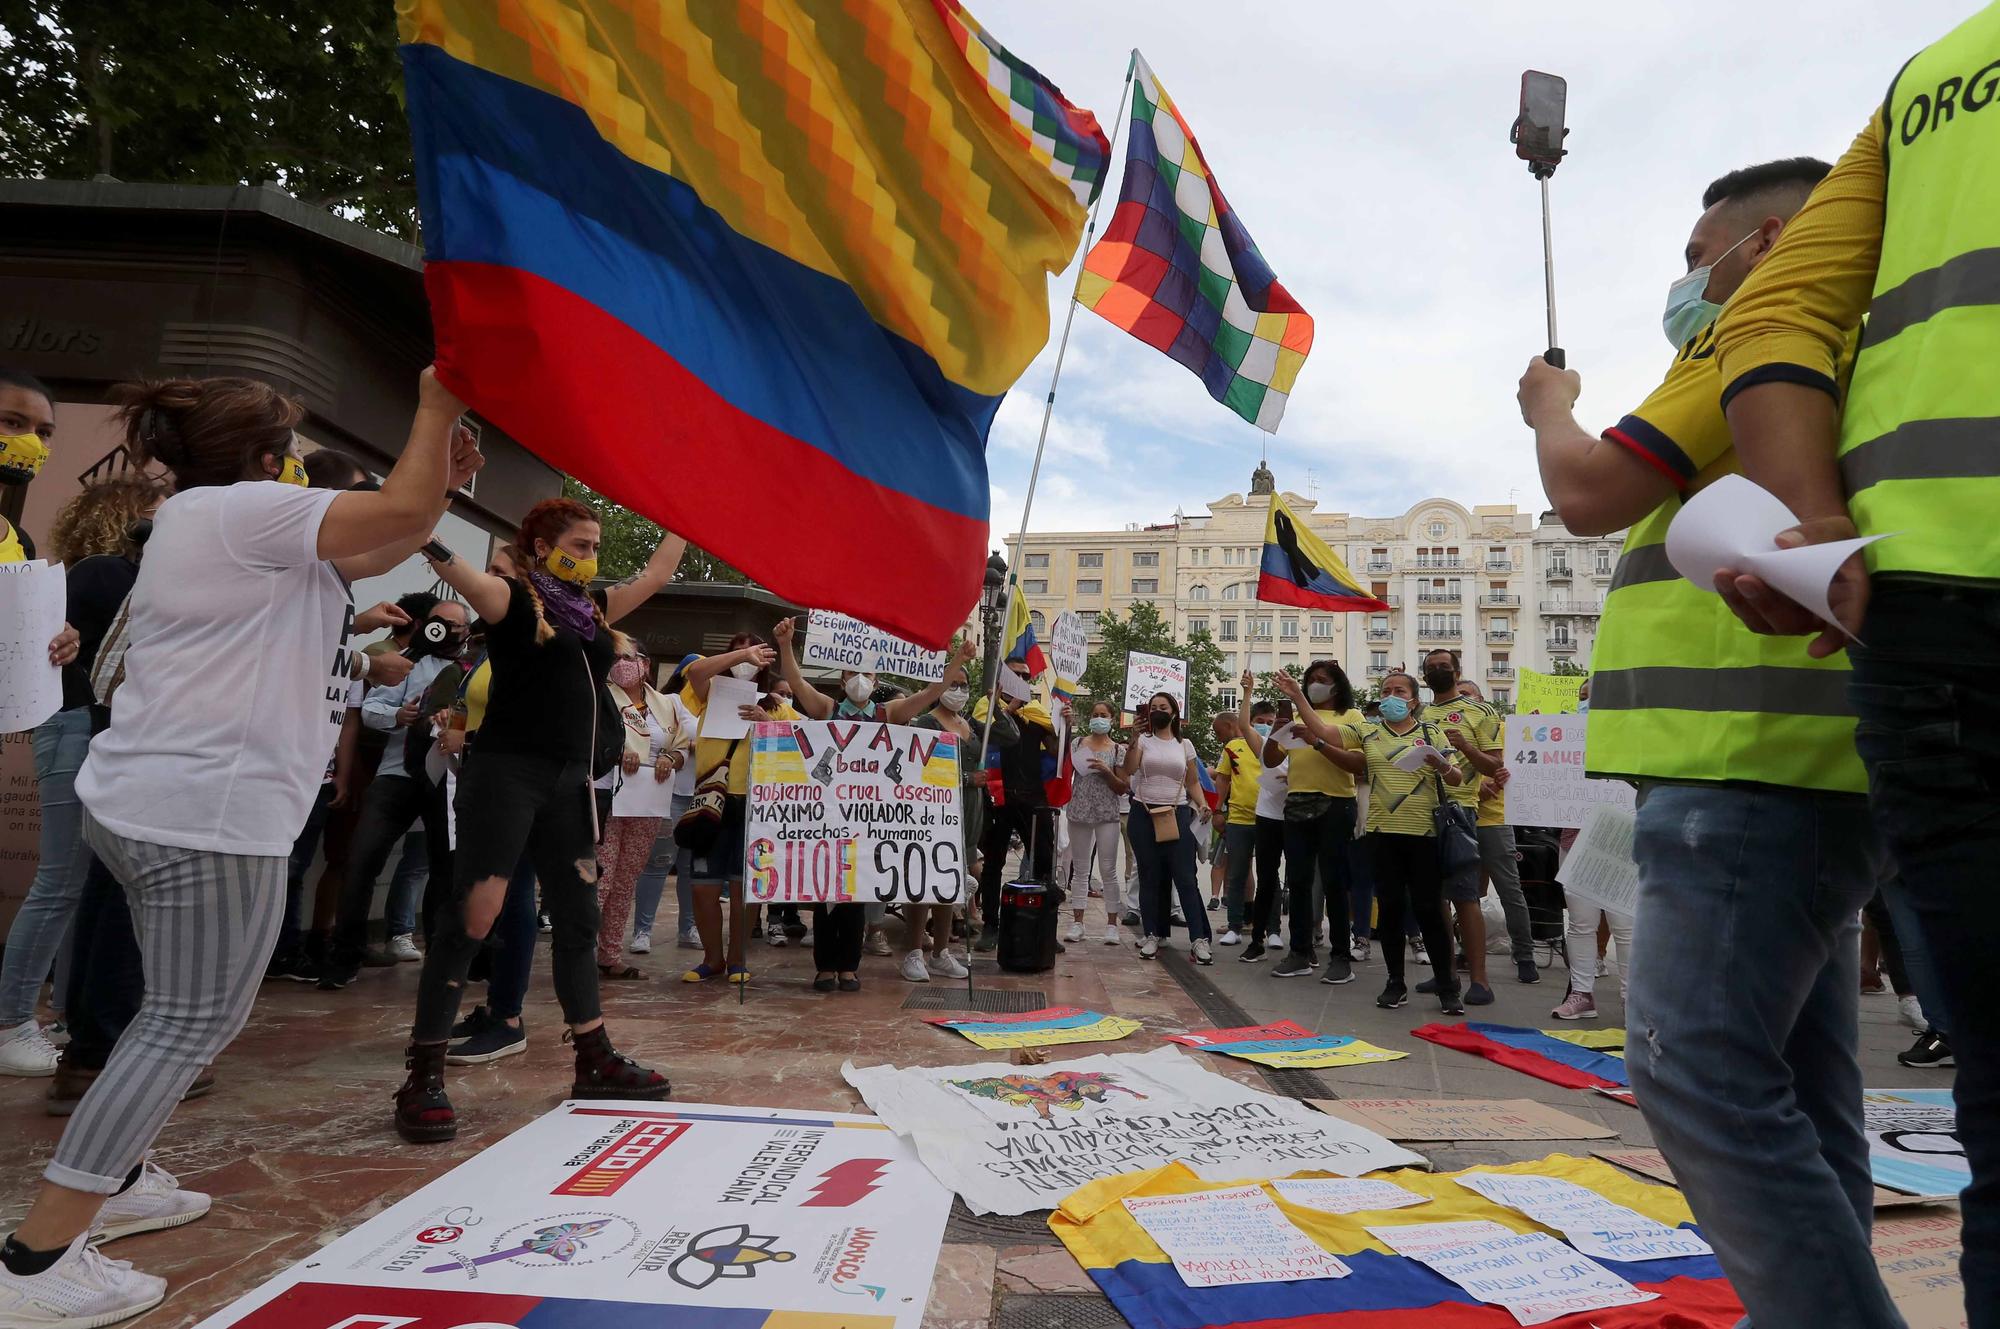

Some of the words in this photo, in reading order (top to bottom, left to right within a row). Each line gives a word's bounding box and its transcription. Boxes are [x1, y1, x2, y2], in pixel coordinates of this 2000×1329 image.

[1901, 59, 2000, 147] ORG
[8, 318, 100, 354] flors
[809, 645, 862, 666] CHALECO
[1137, 665, 1185, 682] IMPUNIDAD
[1170, 663, 1182, 672] de
[326, 687, 340, 702] LA
[1556, 687, 1579, 698] INDIFE
[330, 711, 344, 726] NU
[1522, 725, 1563, 742] 168
[1515, 750, 1538, 764] 42
[10, 776, 28, 787] Mil
[753, 783, 822, 803] gobierno
[894, 783, 953, 804] asesino
[839, 803, 917, 825] VIOLADOR
[920, 806, 936, 825] de
[941, 805, 960, 826] los
[9, 822, 24, 831] on
[777, 823, 850, 840] derechos
[867, 822, 933, 842] humanos
[874, 841, 961, 904] SOS
[595, 1124, 680, 1169] CCOO
[984, 1133, 1054, 1158] UNA
[717, 1140, 791, 1203] VALENCIANA
[751, 1130, 827, 1206] INTERSINDICAL
[381, 1244, 436, 1273] AESCO
[639, 1231, 691, 1272] REVIVIR
[1278, 1254, 1330, 1267] VIOLA
[1179, 1258, 1256, 1273] TORTURA
[1257, 1258, 1273, 1269] Y
[1320, 1262, 1344, 1276] LA
[1543, 1260, 1595, 1282] NOS
[1468, 1274, 1541, 1293] MATAN
